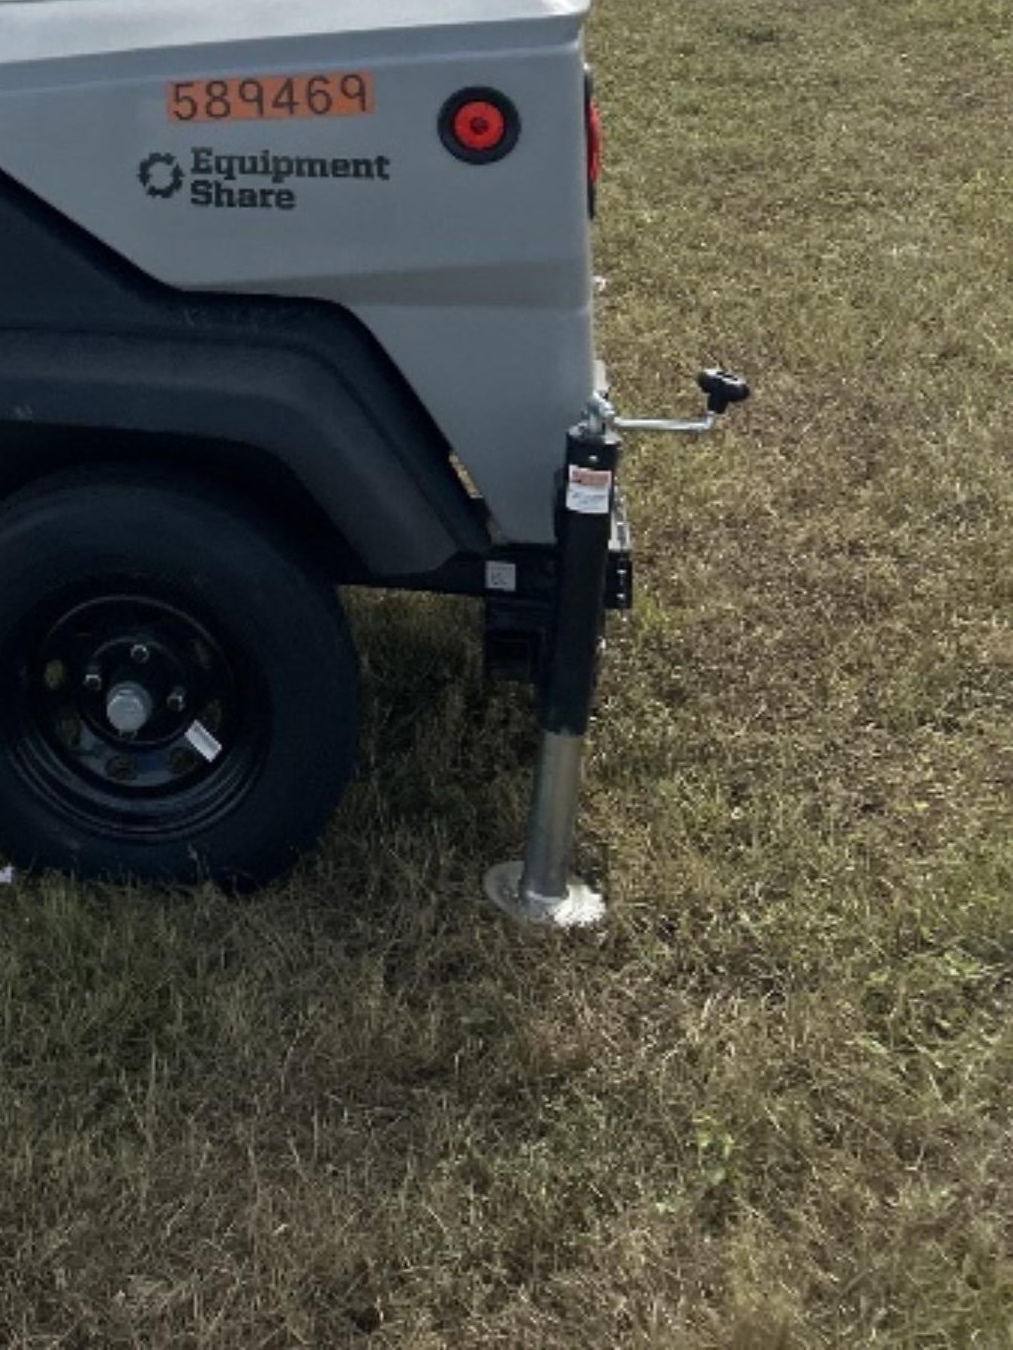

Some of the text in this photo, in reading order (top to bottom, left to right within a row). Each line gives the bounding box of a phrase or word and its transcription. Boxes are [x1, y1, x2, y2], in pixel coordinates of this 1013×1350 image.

[173, 75, 367, 121] 589469
[191, 147, 390, 183] Equipment
[191, 180, 295, 209] Share
